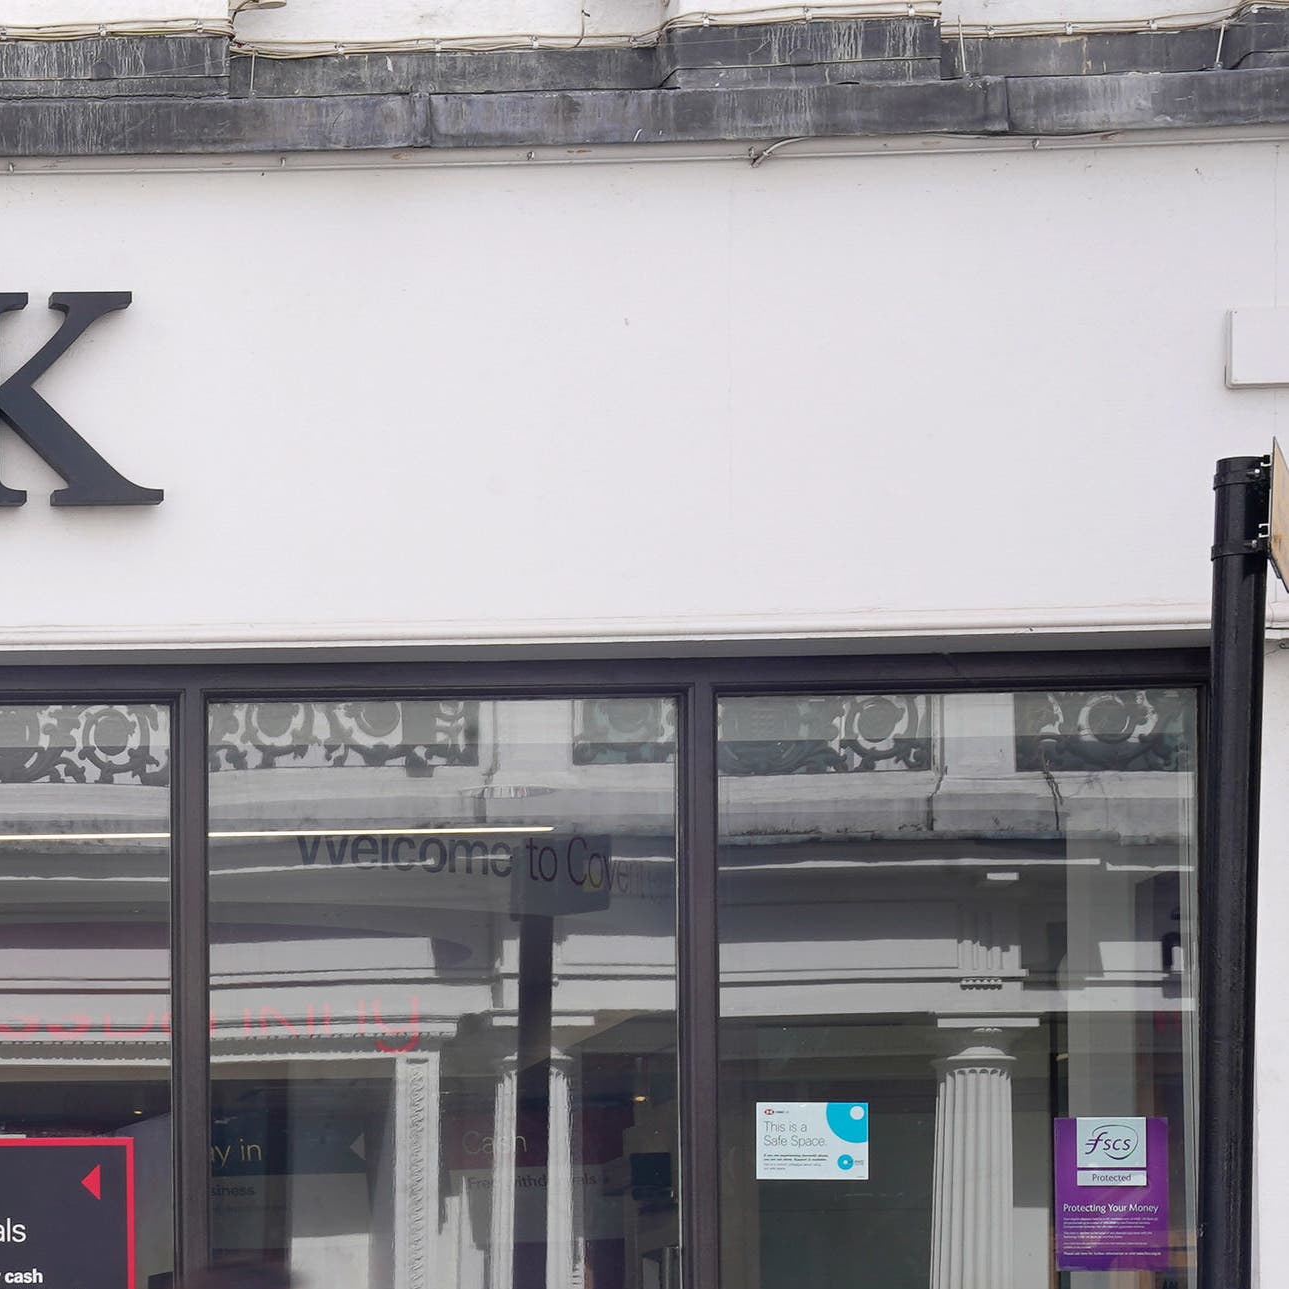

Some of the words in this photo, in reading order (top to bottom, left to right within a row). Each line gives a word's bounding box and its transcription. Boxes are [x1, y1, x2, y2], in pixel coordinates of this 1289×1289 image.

[526, 837, 558, 882] to
[764, 1121, 785, 1132] This
[789, 1123, 797, 1132] is
[764, 1135, 787, 1146] Safe
[1092, 1173, 1132, 1182] Protected
[1063, 1203, 1106, 1213] Protecting
[1108, 1204, 1127, 1212] Your
[1129, 1203, 1158, 1213] Money
[4, 1269, 43, 1285] cash
